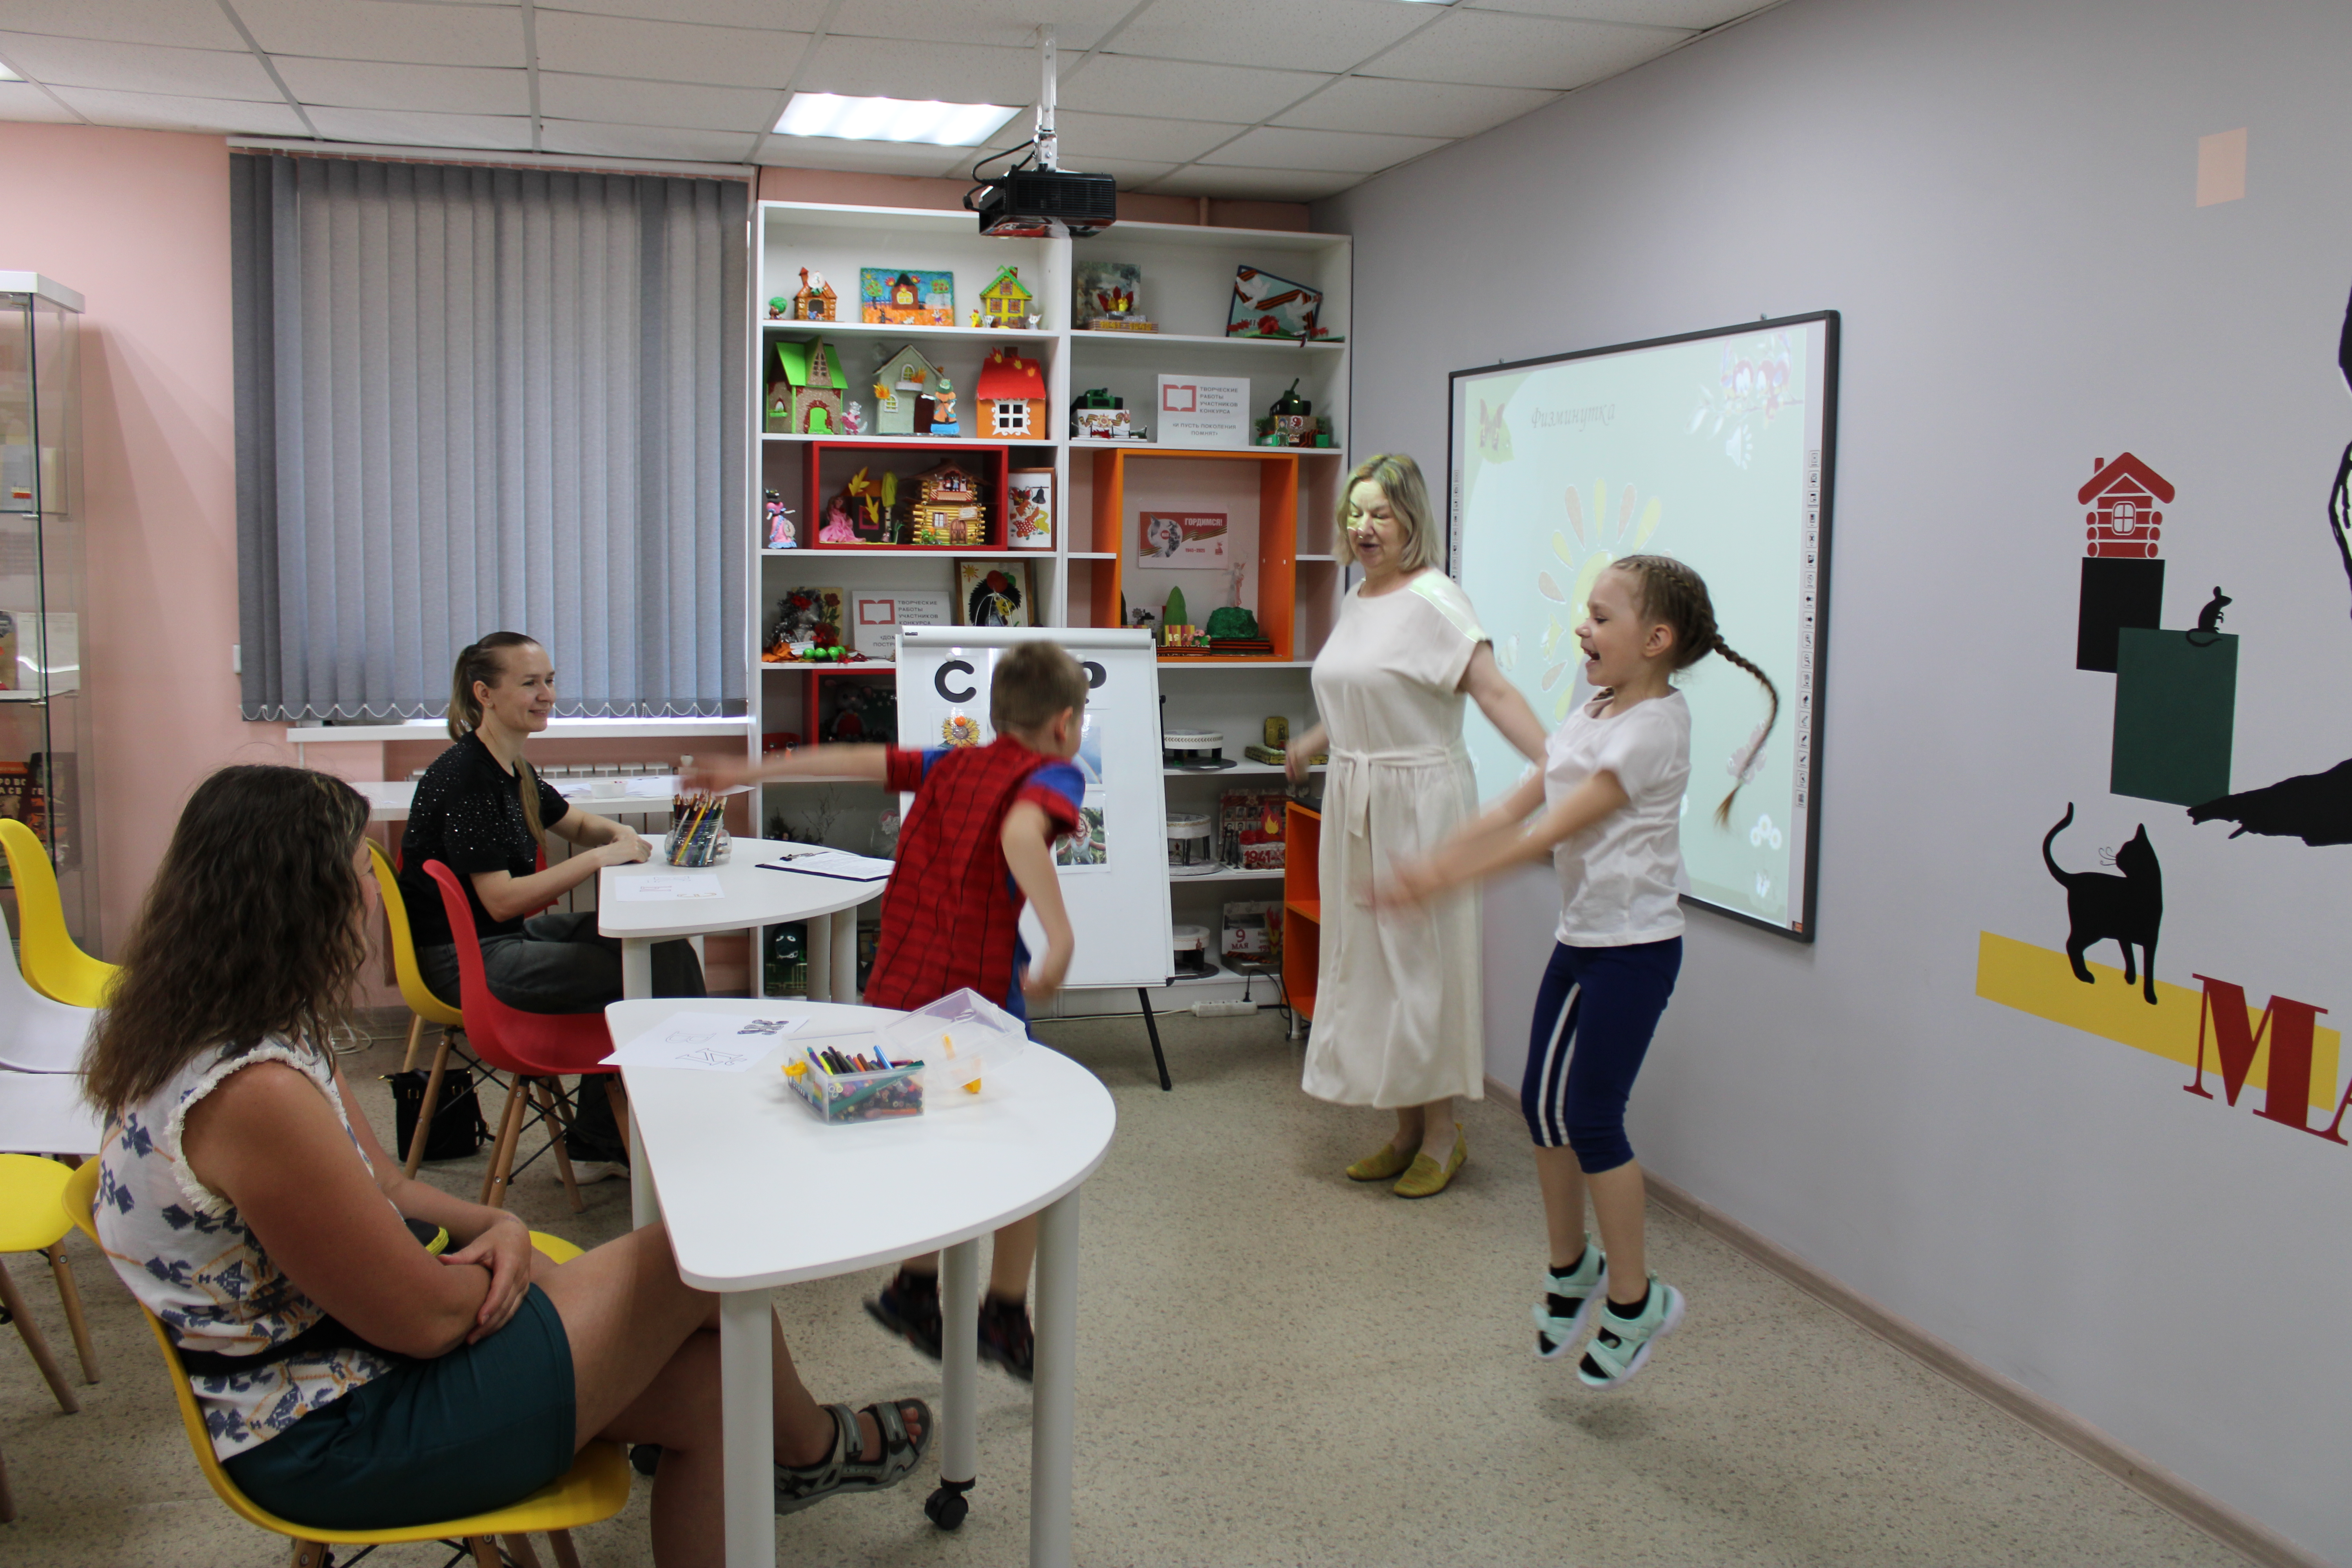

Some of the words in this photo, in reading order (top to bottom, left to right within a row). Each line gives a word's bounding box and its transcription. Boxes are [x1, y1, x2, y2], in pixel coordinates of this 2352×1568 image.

[1532, 404, 1615, 432] Физминутка
[1185, 518, 1223, 526] ГОРДИМСЯ!
[935, 660, 977, 703] С
[1236, 929, 1246, 943] 9
[2183, 973, 2352, 1147] М
